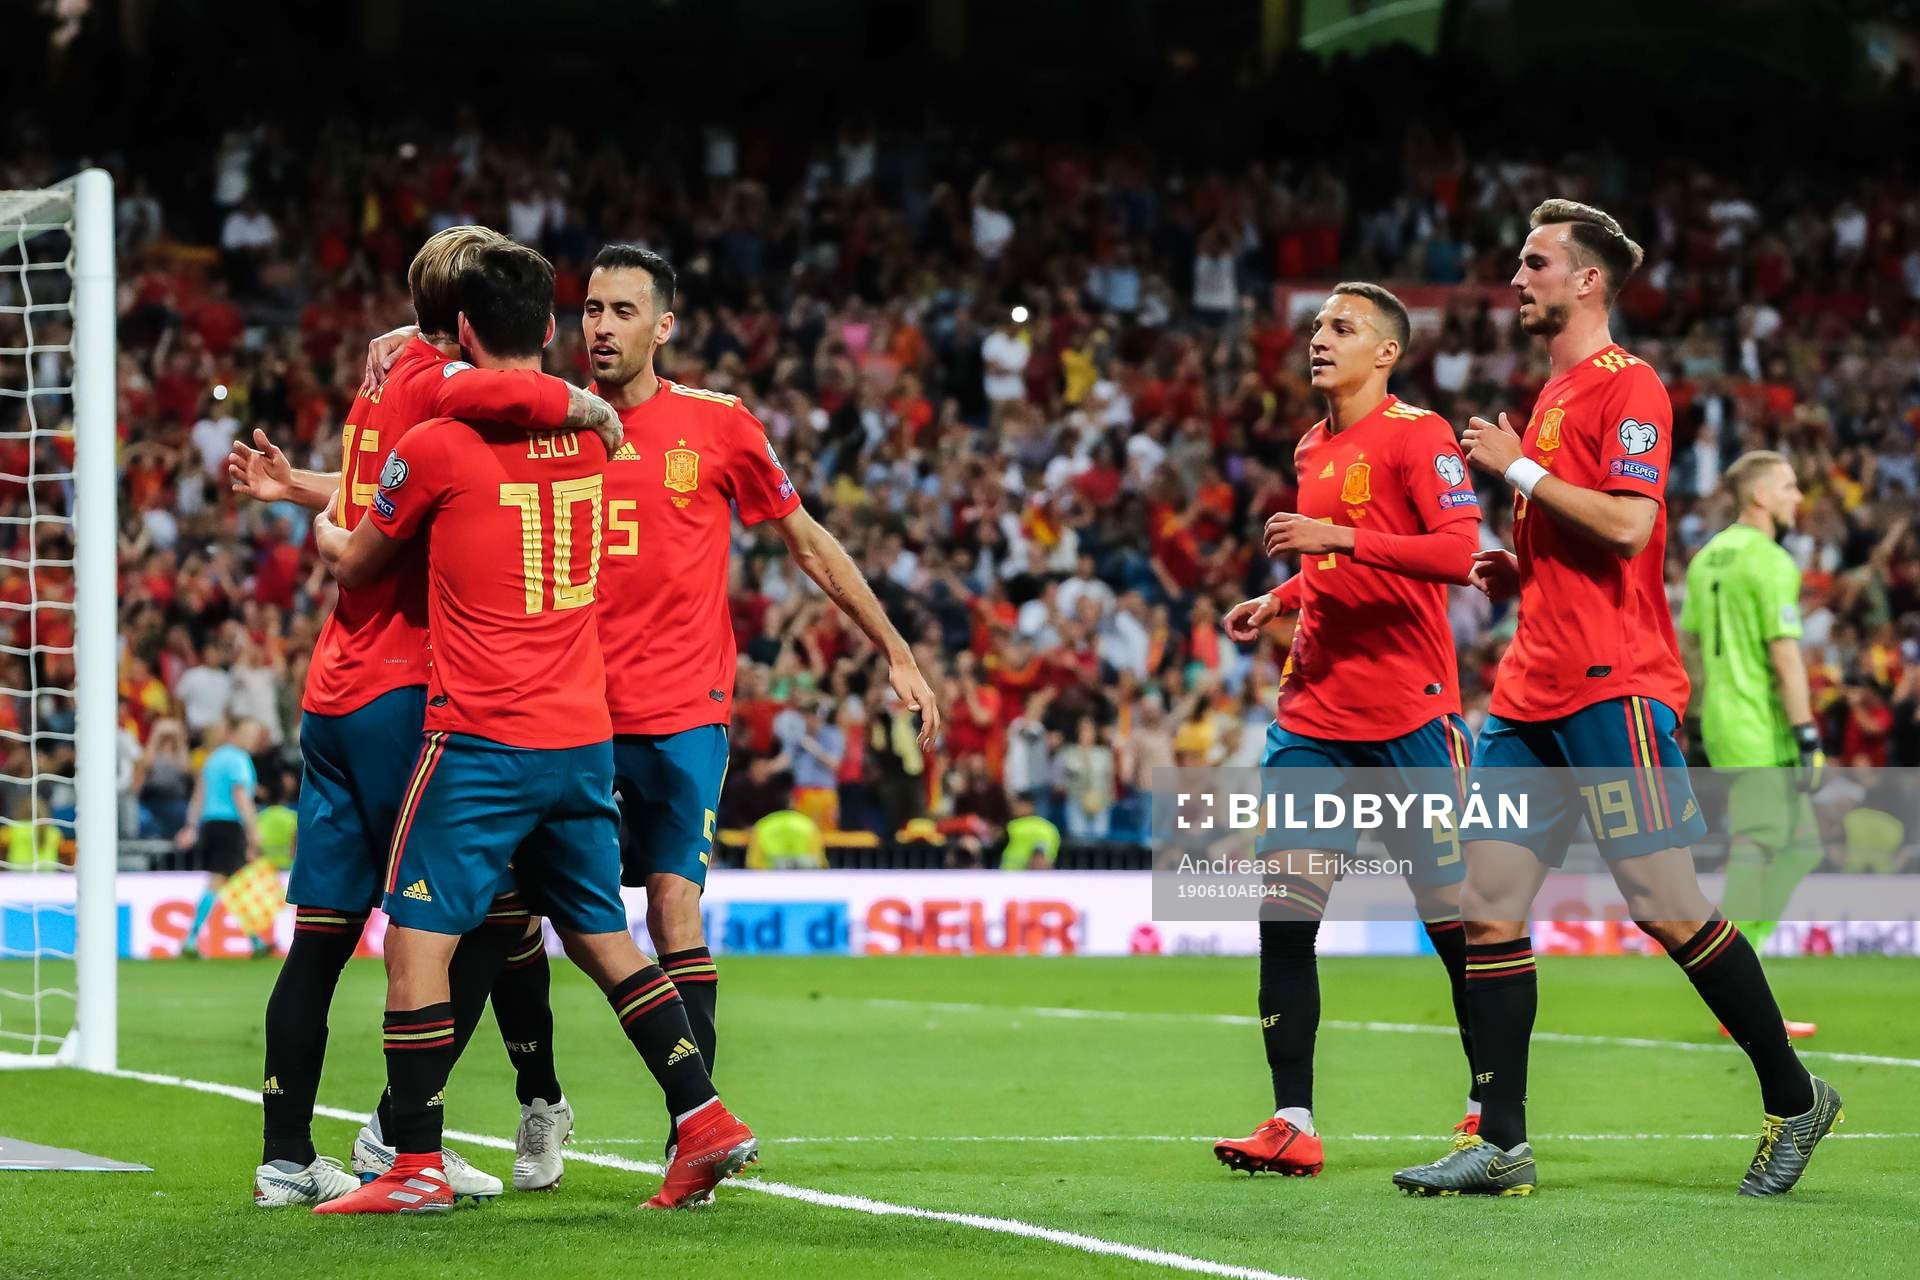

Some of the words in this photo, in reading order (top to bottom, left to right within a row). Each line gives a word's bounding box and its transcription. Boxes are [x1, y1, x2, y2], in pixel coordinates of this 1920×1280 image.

[527, 431, 579, 459] ISCO
[1623, 463, 1658, 479] RESPECT
[499, 474, 603, 615] 10
[607, 500, 639, 556] 5
[1710, 580, 1722, 656] 1
[1579, 779, 1640, 840] 19
[865, 898, 1078, 954] SEUR
